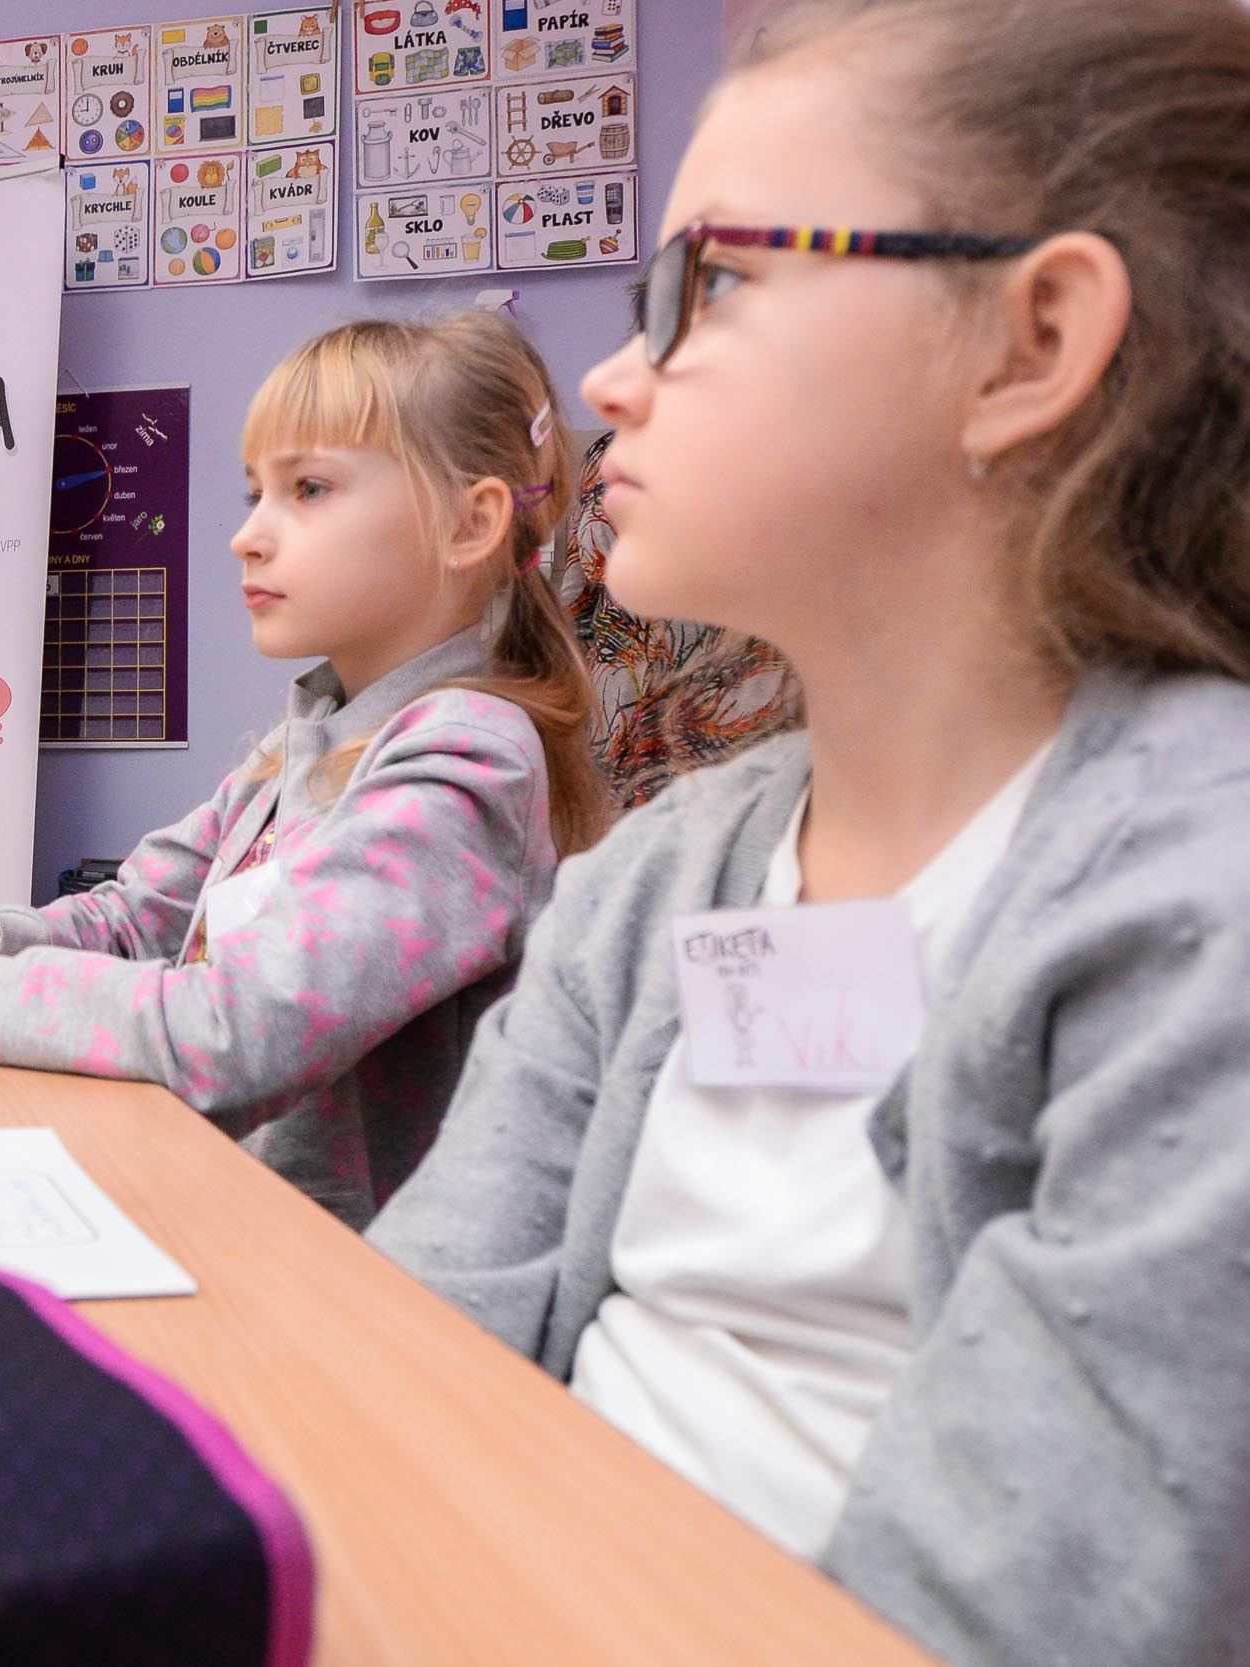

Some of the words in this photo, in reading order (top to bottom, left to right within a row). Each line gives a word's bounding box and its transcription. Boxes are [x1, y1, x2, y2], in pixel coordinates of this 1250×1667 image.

[538, 10, 590, 32] PAPÍR
[267, 37, 320, 55] ČTVEREC
[394, 30, 447, 50] LÁTKA
[172, 49, 229, 67] OBDÉLNÍK
[92, 62, 124, 77] KRUH
[541, 110, 595, 130] DŘEVO
[409, 127, 440, 143] KOV
[269, 179, 314, 200] KVÁDR
[84, 200, 133, 215] KRYCHLE
[178, 194, 217, 209] KOULE
[405, 219, 443, 234] SKLO
[541, 210, 594, 228] PLAST
[78, 424, 98, 433] leden
[135, 424, 154, 447] zima
[114, 491, 136, 500] duben
